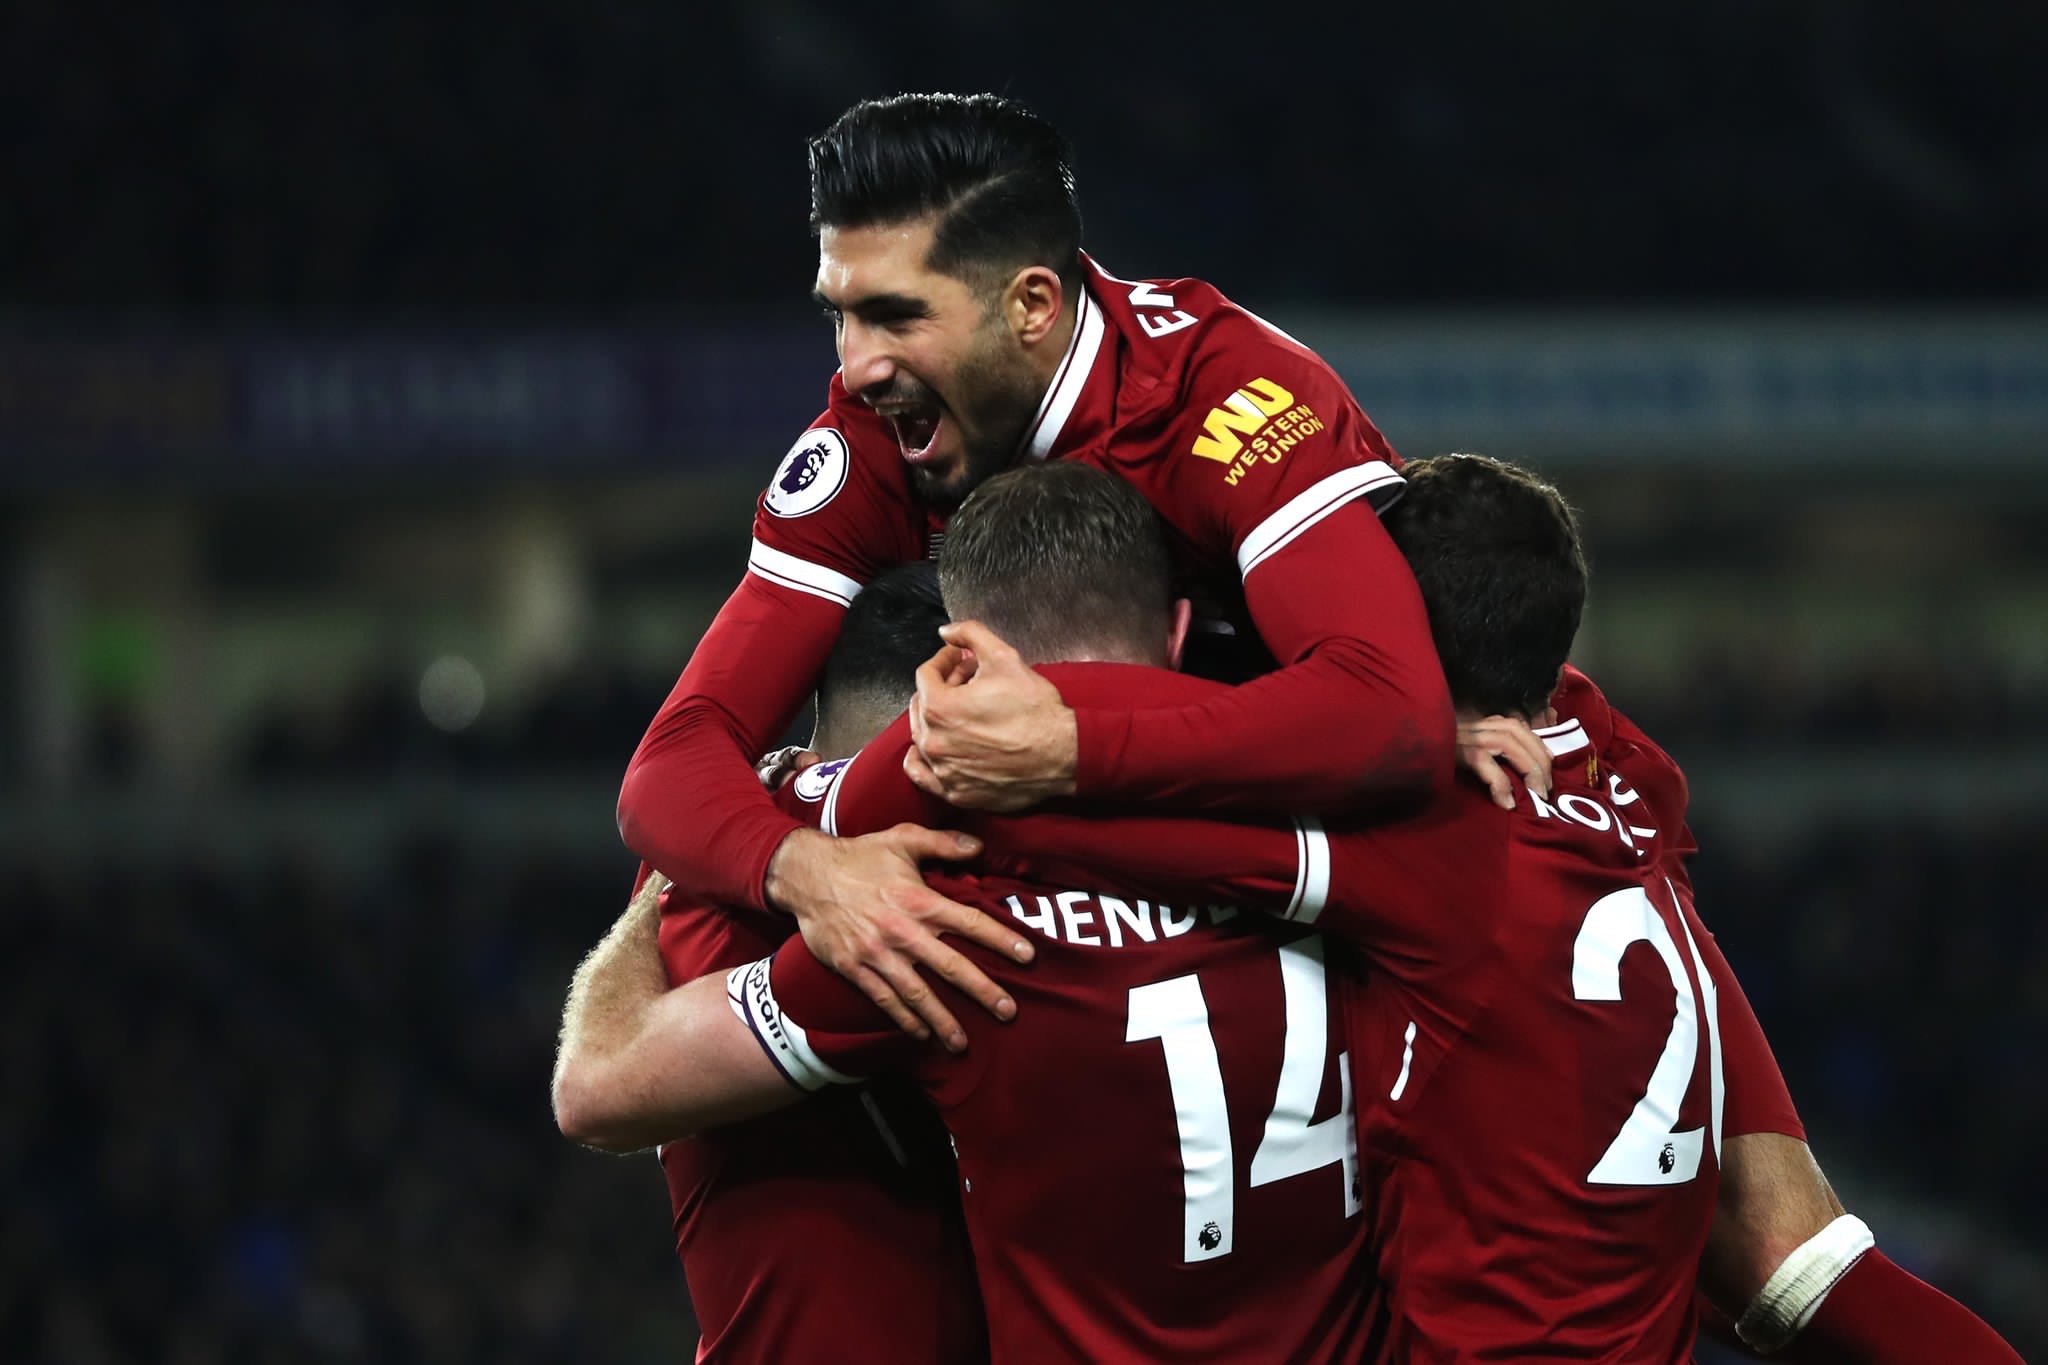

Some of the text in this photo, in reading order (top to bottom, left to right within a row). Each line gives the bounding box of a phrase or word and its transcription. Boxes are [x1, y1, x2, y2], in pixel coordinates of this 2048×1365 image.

[1192, 377, 1294, 465] WU
[1224, 404, 1314, 487] WESTERN
[1261, 416, 1325, 465] UNION
[1125, 932, 1362, 1264] 14
